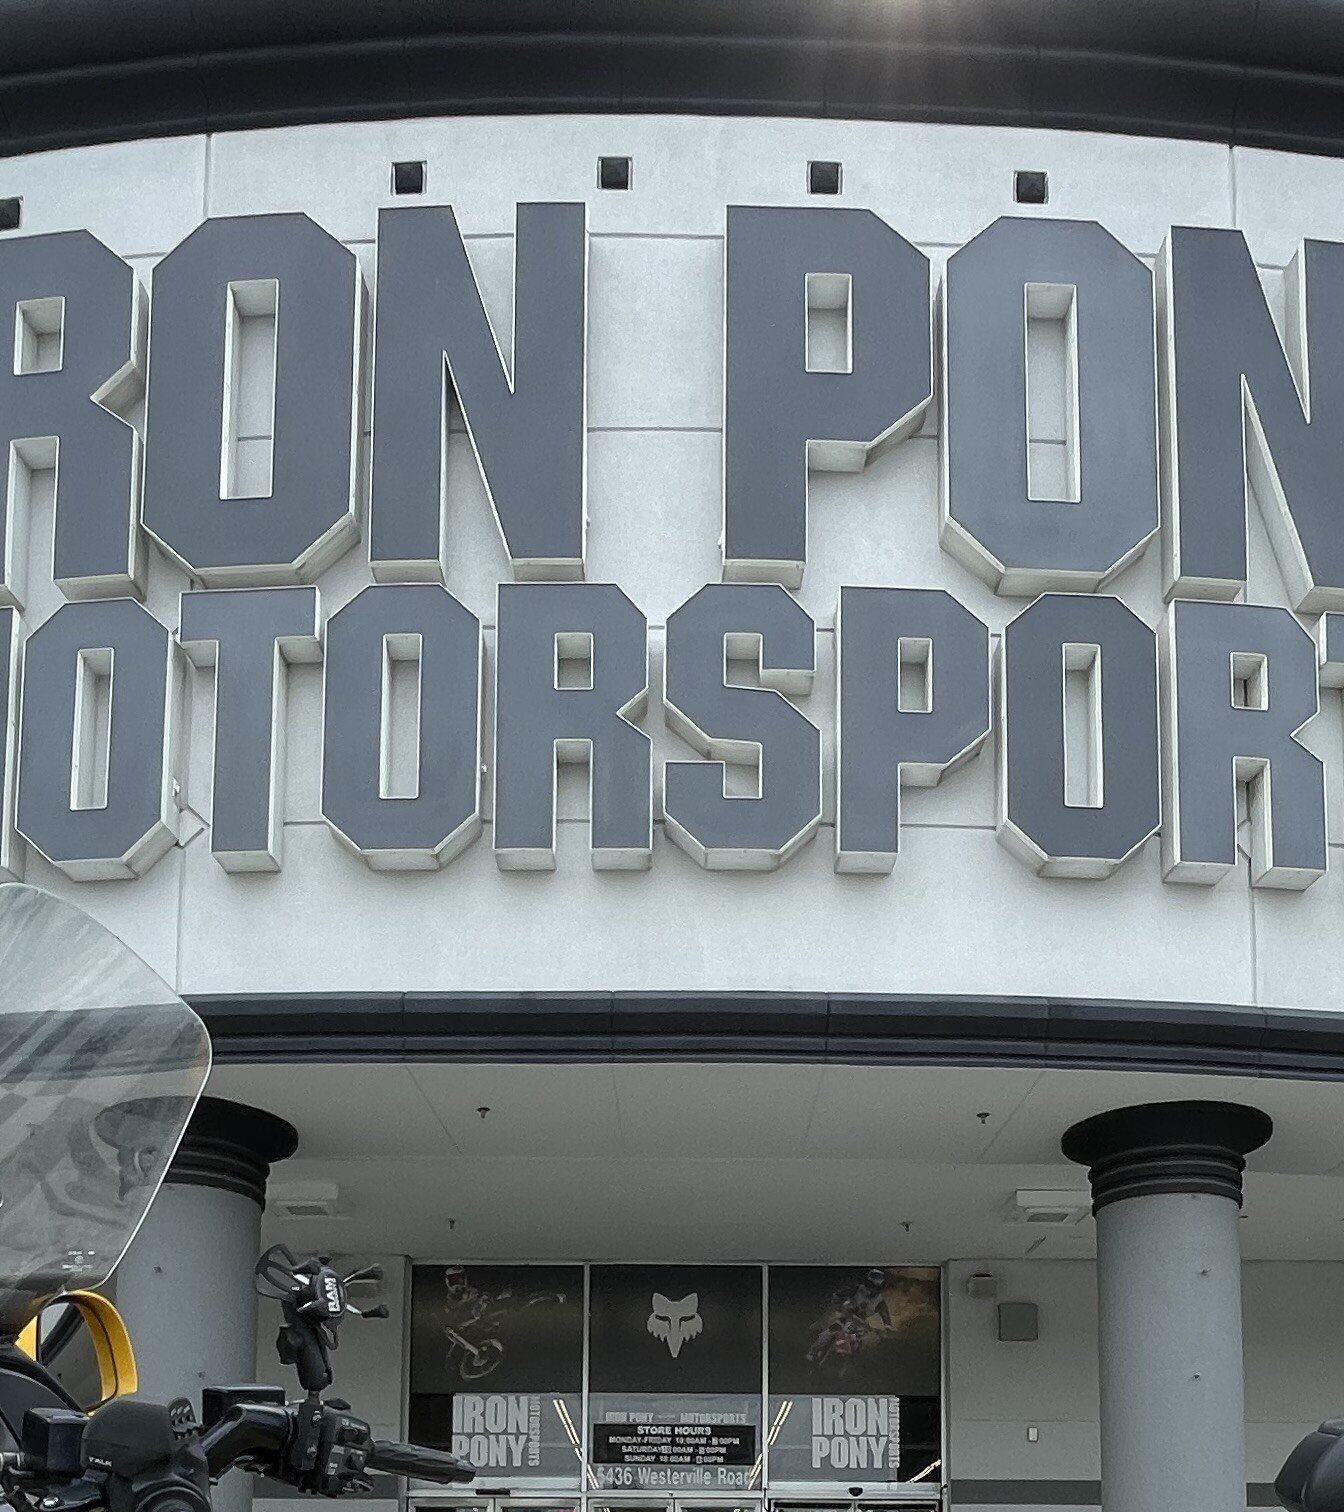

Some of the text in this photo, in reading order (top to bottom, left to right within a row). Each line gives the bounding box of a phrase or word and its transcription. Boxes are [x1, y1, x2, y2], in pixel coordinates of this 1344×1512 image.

[324, 1277, 341, 1312] RAM
[452, 1396, 529, 1433] IRON
[637, 1426, 712, 1435] STORE HOURS
[812, 1397, 888, 1435] IRON
[452, 1434, 528, 1467] PONY
[812, 1436, 888, 1468] PONY
[637, 1467, 712, 1485] Westerville
